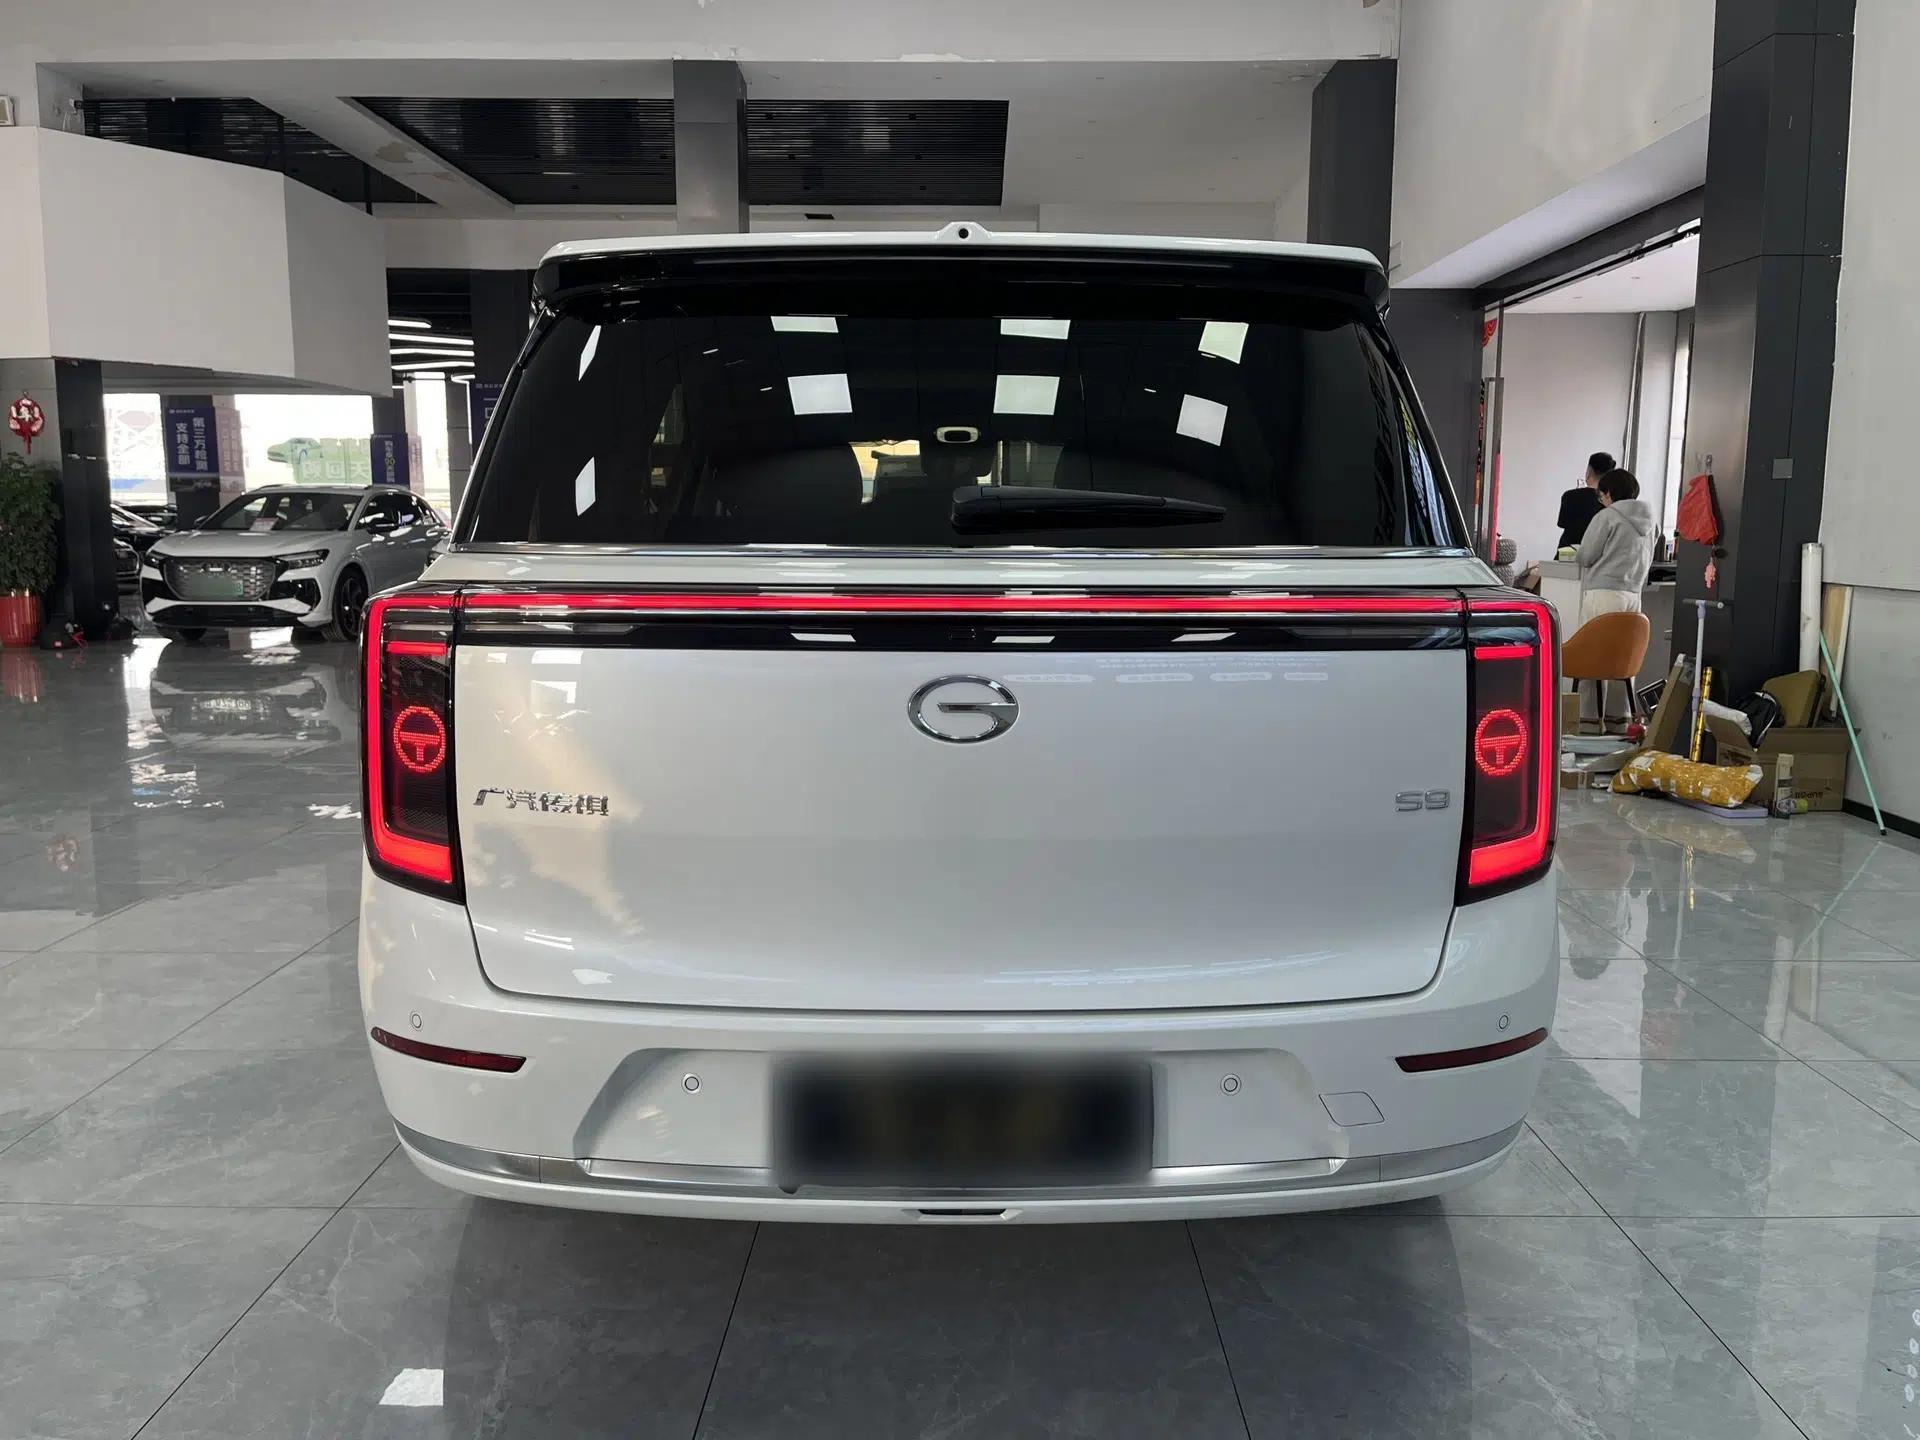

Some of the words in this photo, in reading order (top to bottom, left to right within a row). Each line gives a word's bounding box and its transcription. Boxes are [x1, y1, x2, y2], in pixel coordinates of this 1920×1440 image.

[473, 787, 609, 816] 广汽传祺
[1395, 789, 1450, 812] S9
